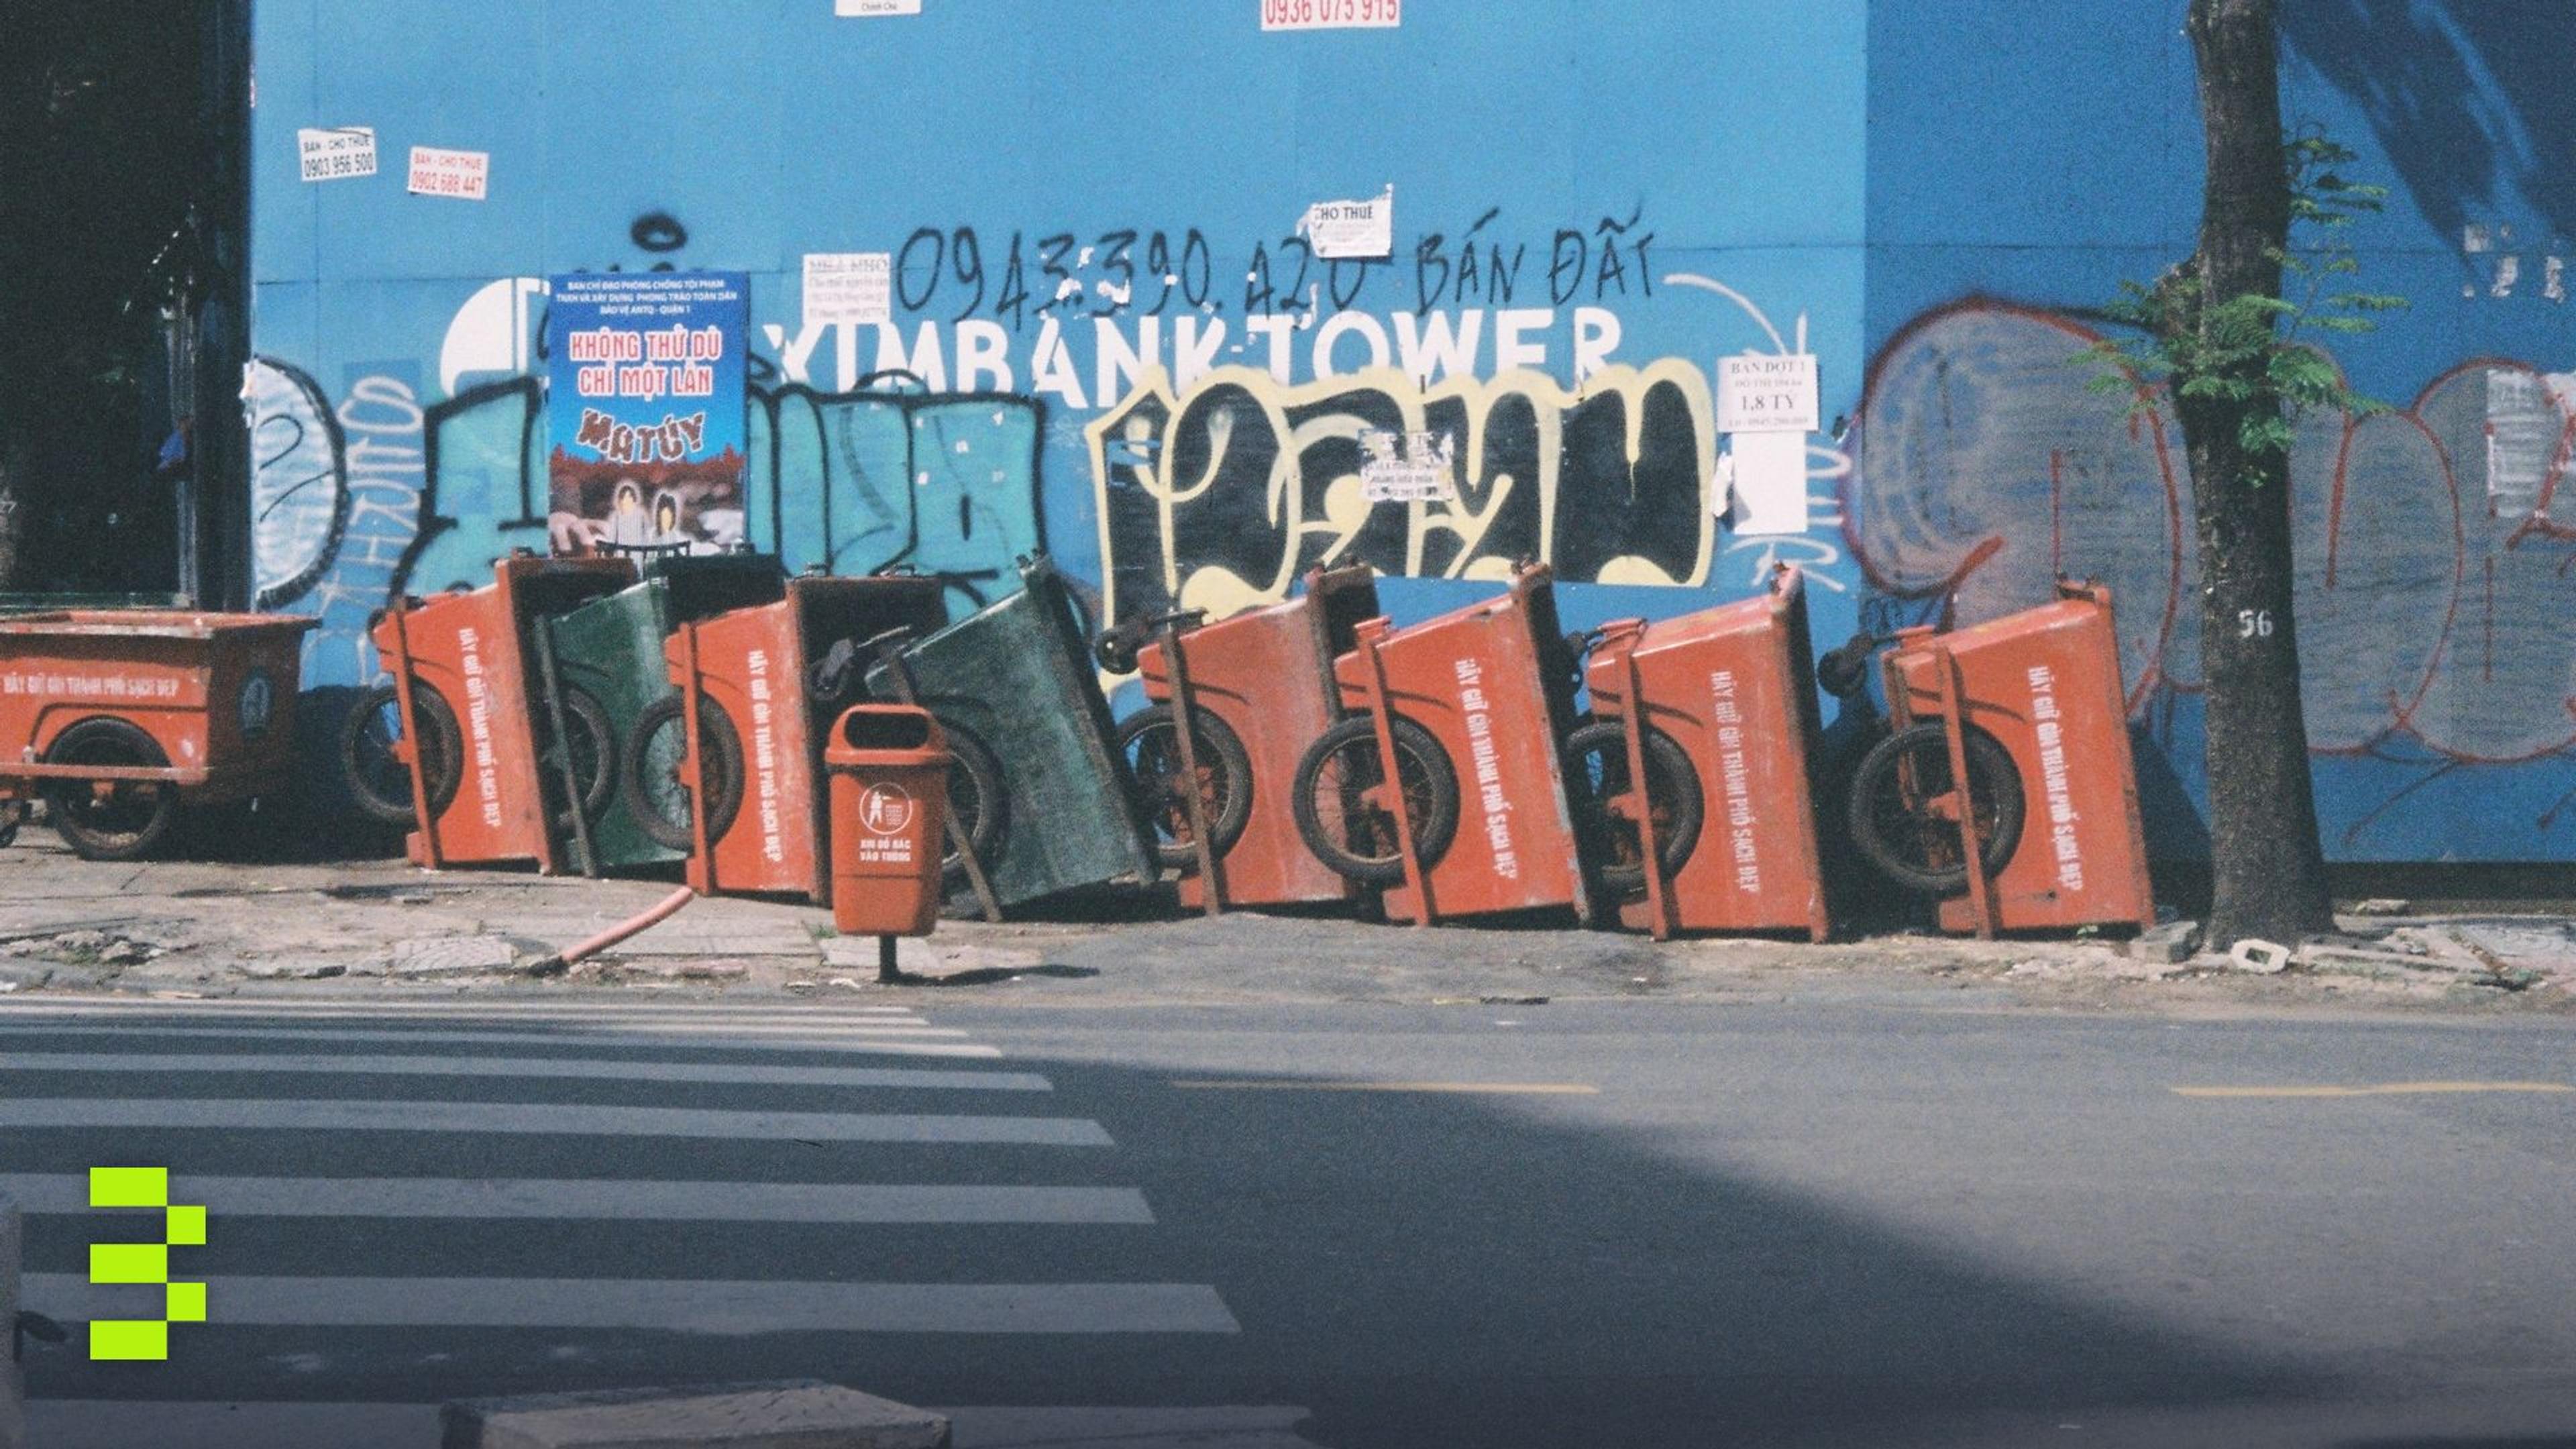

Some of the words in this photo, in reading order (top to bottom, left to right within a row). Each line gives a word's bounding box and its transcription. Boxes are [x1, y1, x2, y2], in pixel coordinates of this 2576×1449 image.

[1265, 0, 1311, 23] 0936
[1320, 0, 1354, 21] 075
[1362, 0, 1397, 21] 915
[305, 158, 330, 177] 0903
[333, 155, 352, 174] 956
[355, 152, 374, 172] 500
[1417, 207, 1524, 315] BÁN
[686, 305, 690, 314] 1
[570, 326, 641, 361] KHÔNG
[619, 361, 667, 401] MỘT
[1741, 394, 1766, 411] 1,8
[2239, 610, 2273, 638] 56
